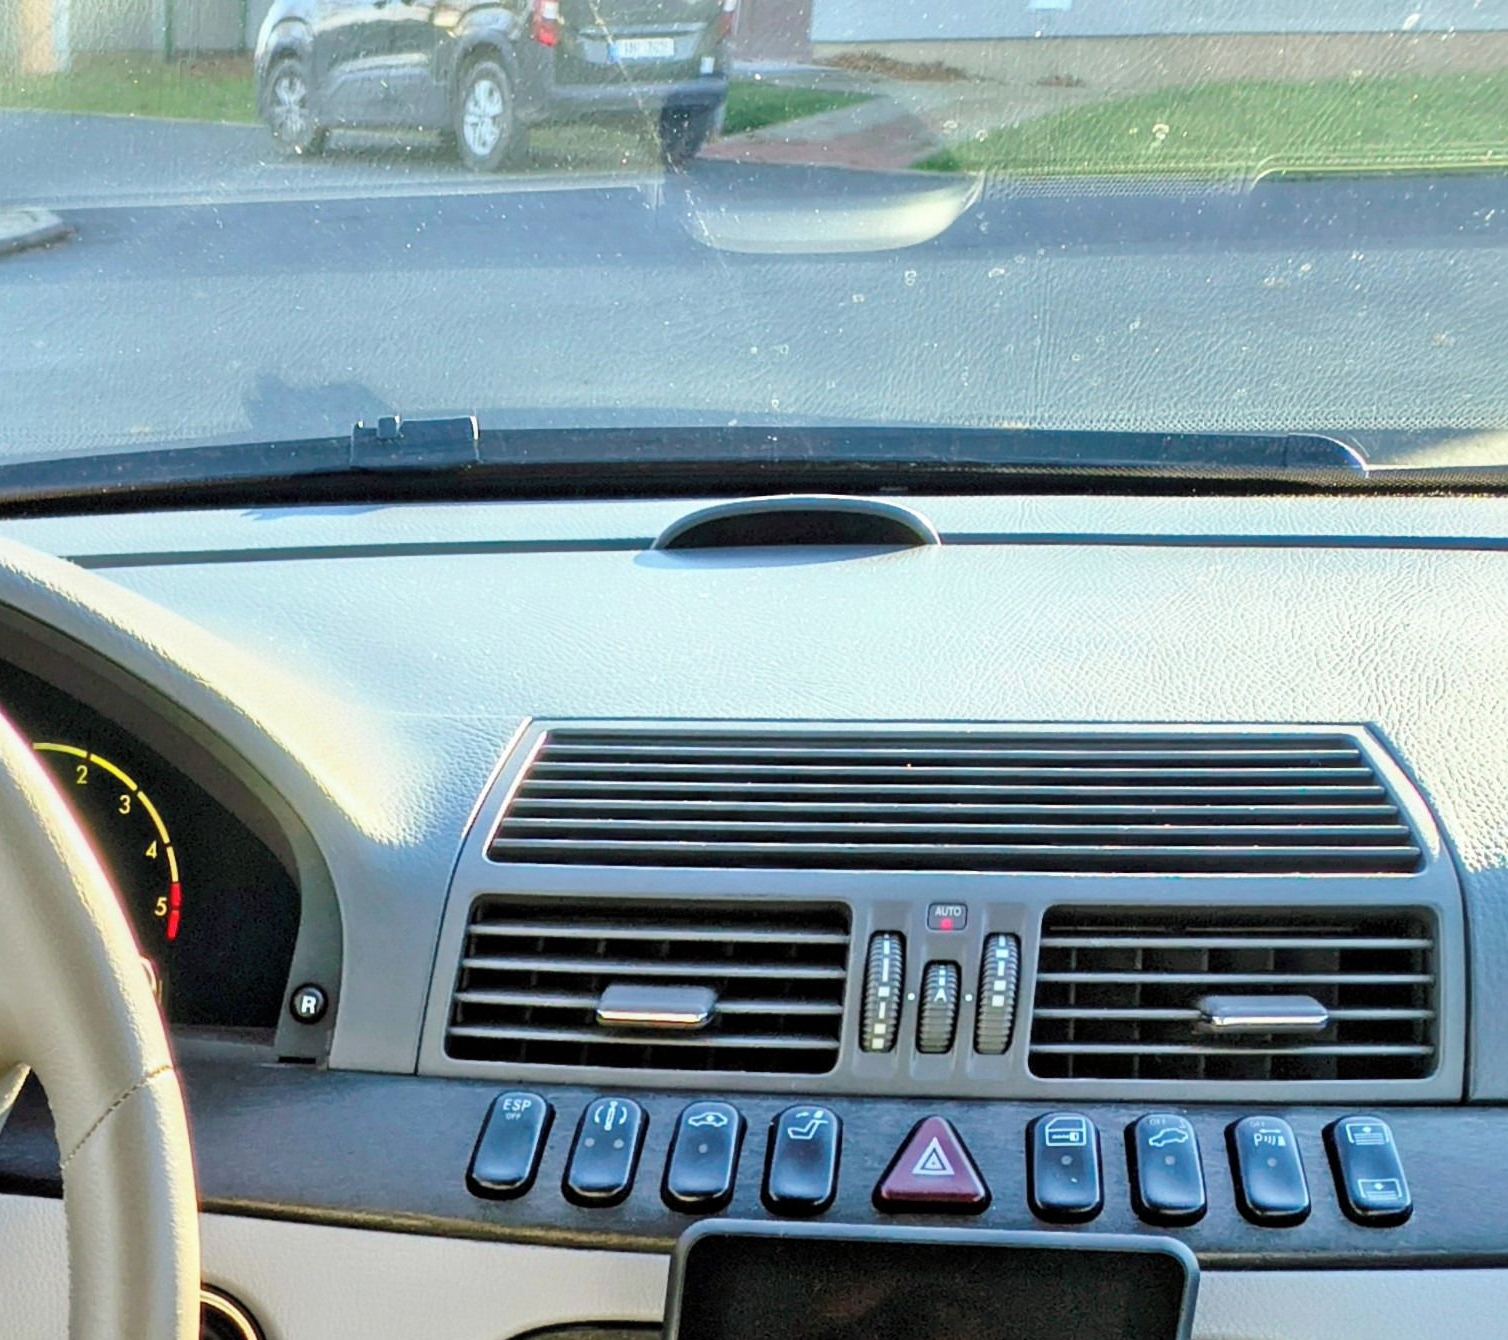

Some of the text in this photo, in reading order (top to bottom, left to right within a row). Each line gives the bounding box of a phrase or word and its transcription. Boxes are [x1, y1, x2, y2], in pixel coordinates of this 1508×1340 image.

[76, 764, 88, 785] 2
[119, 795, 131, 815] 3
[145, 841, 158, 860] 4
[154, 898, 167, 917] 5
[934, 907, 962, 917] AUTO
[300, 995, 316, 1014] R
[502, 1098, 532, 1112] ESP
